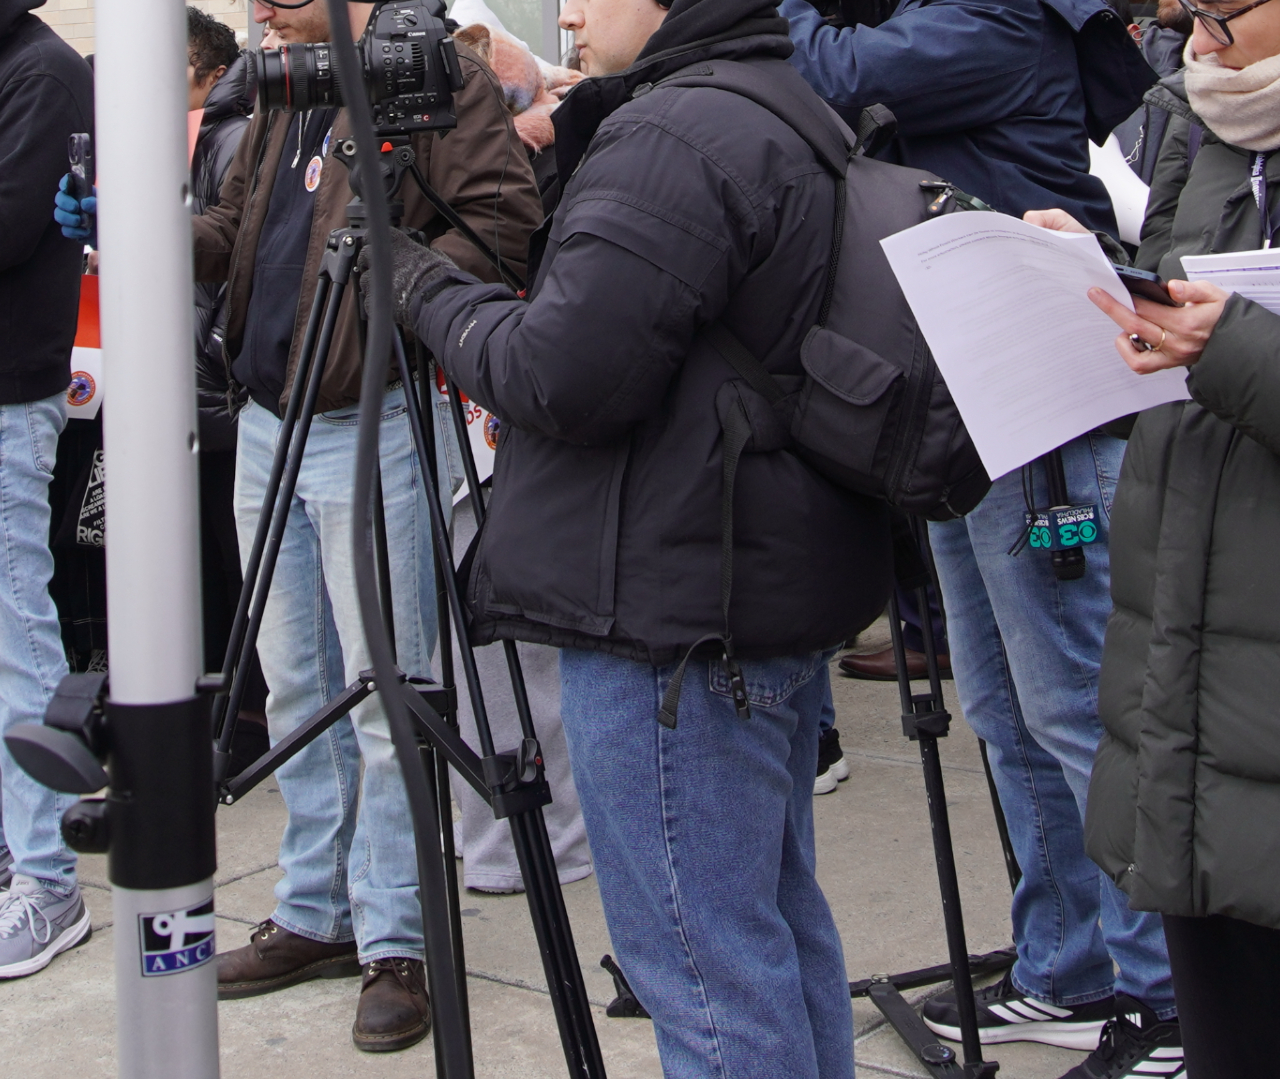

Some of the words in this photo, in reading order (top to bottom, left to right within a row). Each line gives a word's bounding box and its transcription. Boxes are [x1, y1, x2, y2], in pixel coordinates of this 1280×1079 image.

[1056, 507, 1094, 518] PHILADELPHIA
[1057, 516, 1077, 525] NEWS
[1059, 524, 1079, 546] 3
[152, 939, 215, 971] ANC
